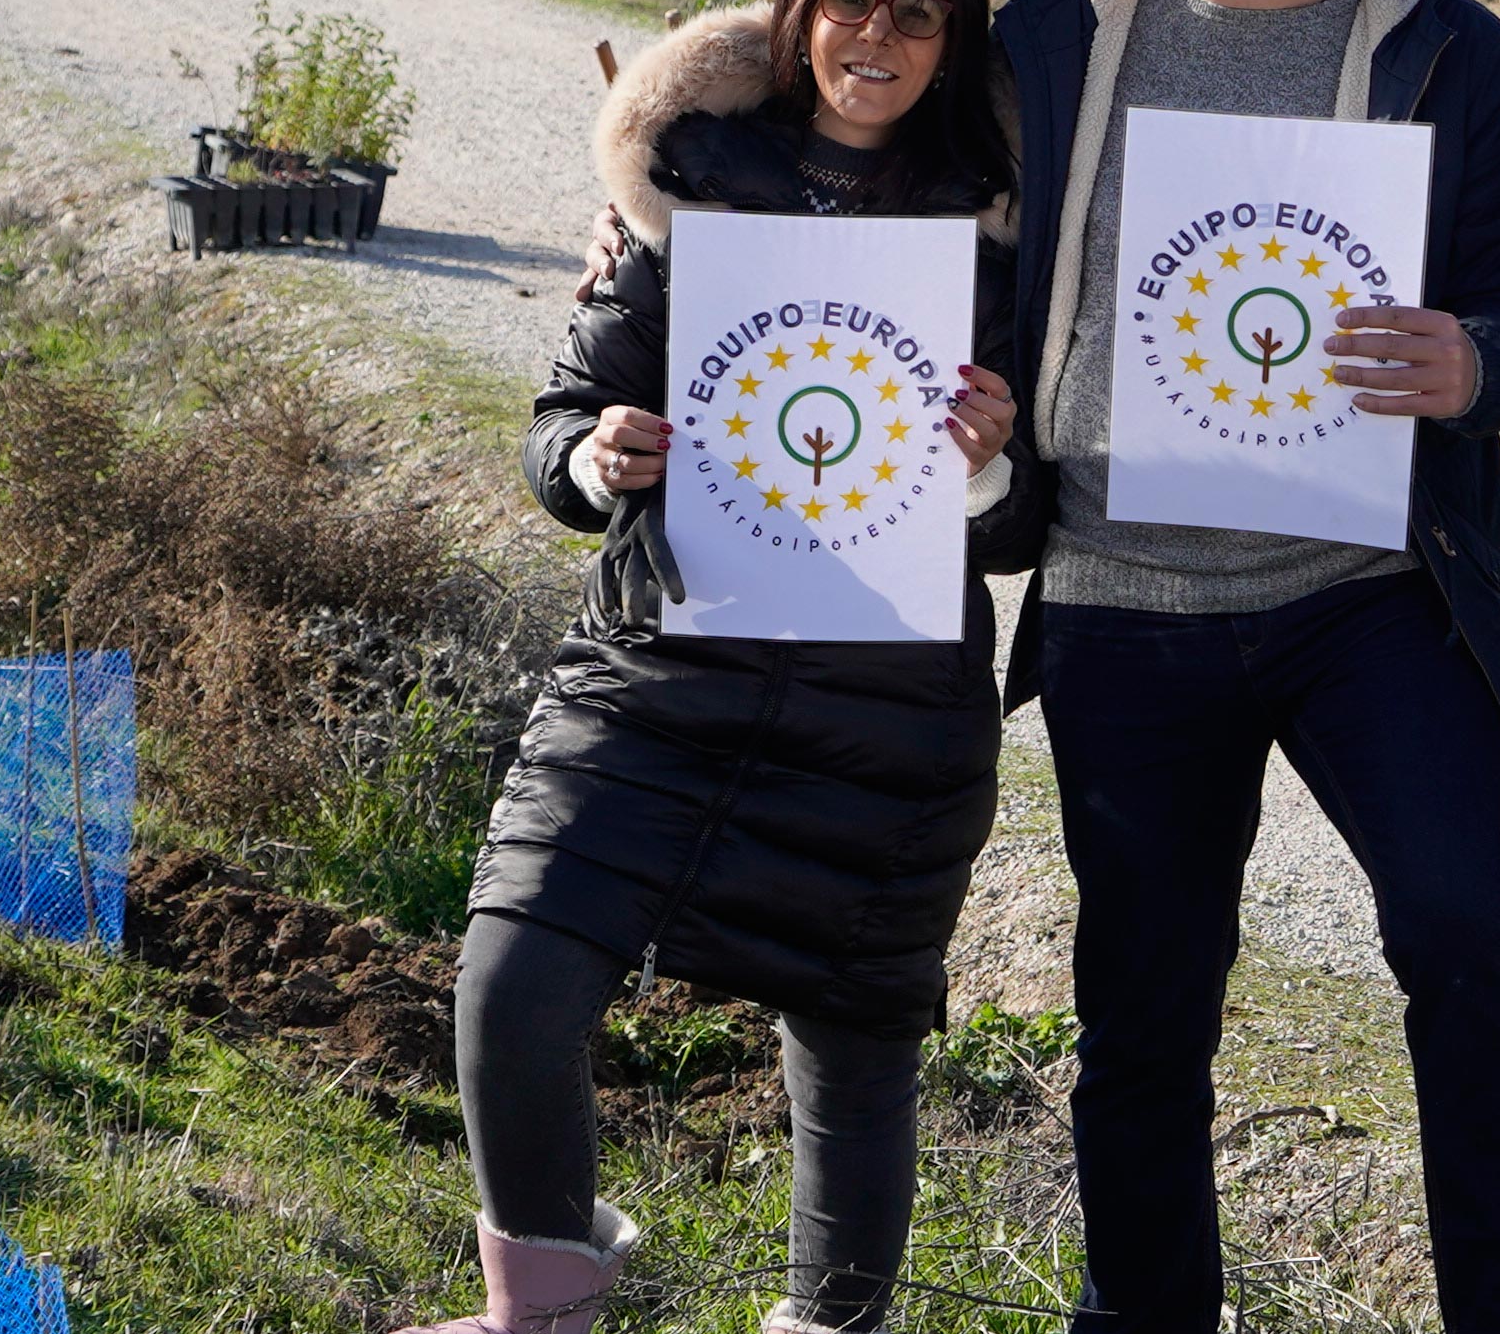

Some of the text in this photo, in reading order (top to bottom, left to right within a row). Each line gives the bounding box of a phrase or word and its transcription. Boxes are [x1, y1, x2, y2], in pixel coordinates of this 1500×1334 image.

[1137, 203, 1257, 301] EQUIPO
[688, 301, 944, 408] EQUIPO EUROPA
